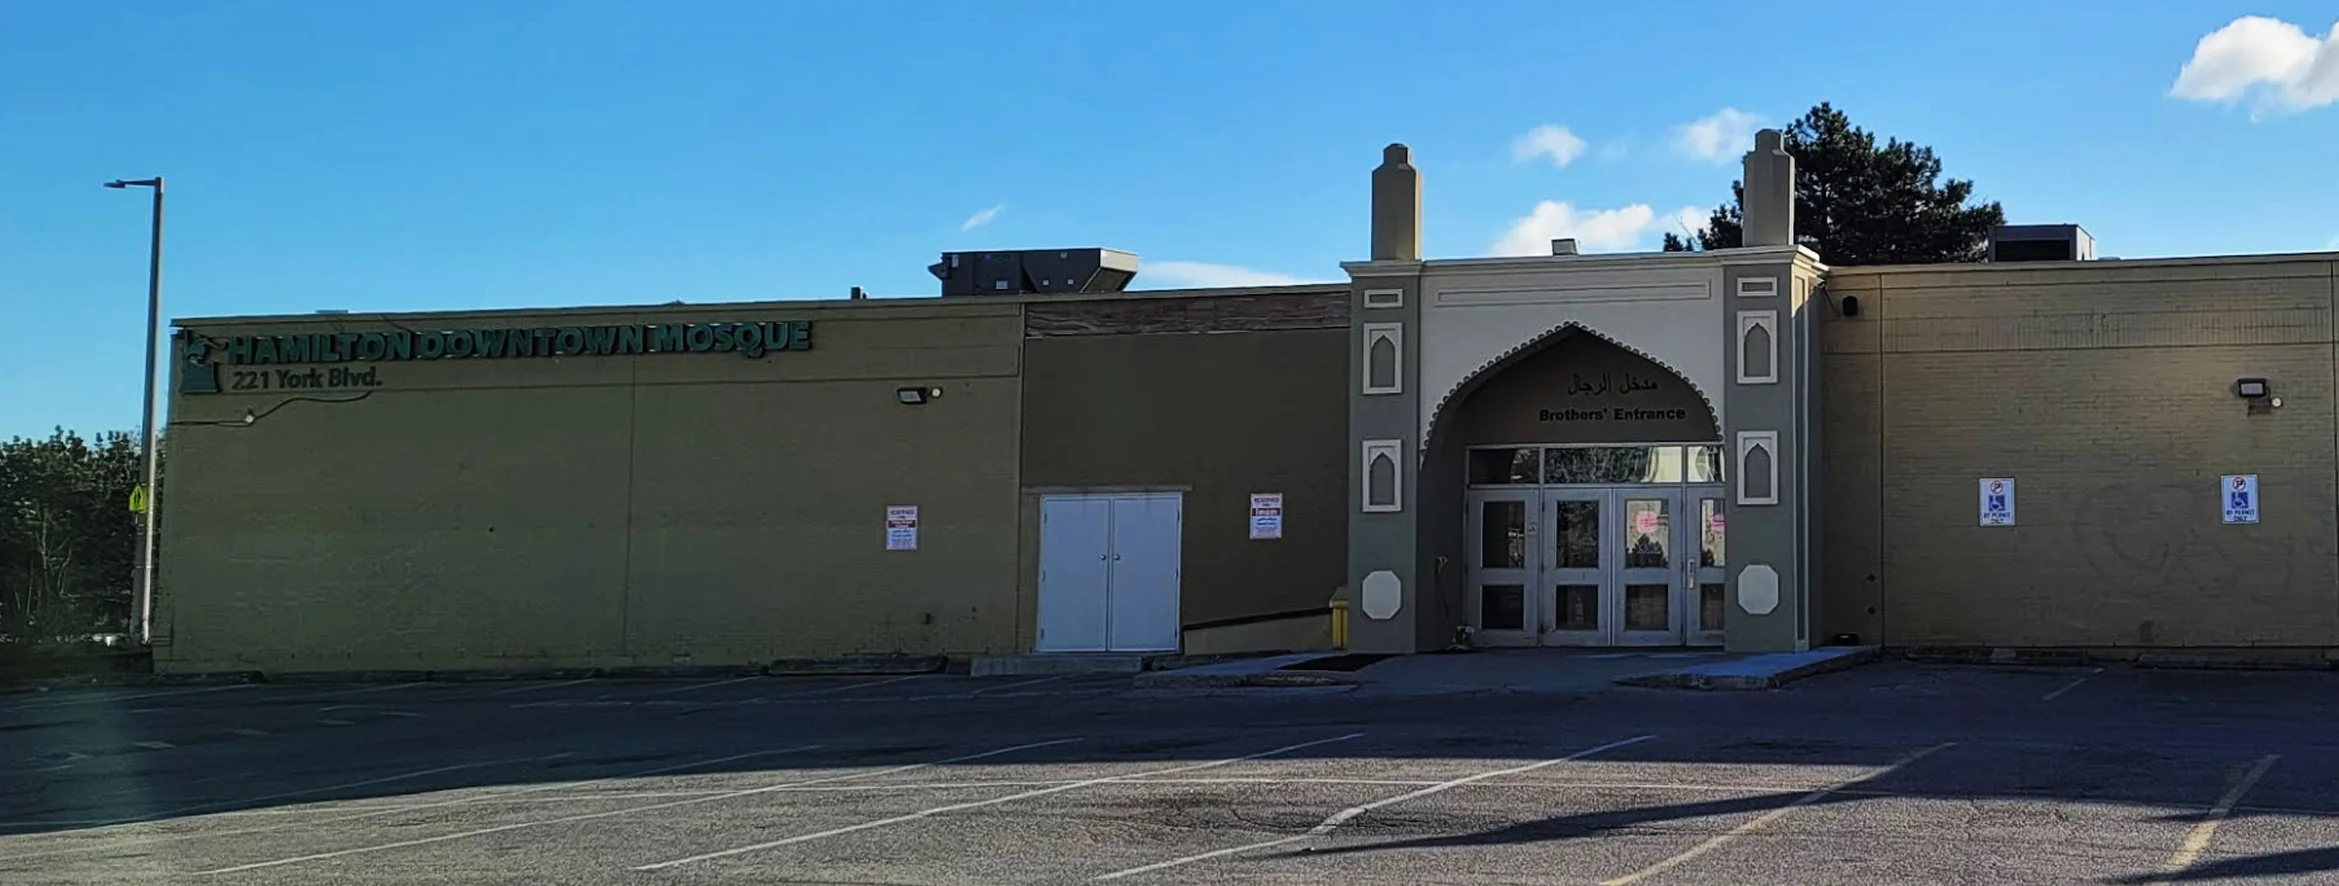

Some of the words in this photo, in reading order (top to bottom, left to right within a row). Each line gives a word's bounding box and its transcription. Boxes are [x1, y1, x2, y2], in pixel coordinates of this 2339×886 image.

[227, 332, 412, 364] HAMILTON
[416, 327, 643, 359] DOWNTOWN
[651, 320, 812, 358] MOSQUE
[231, 371, 269, 390] 221
[275, 368, 322, 389] York
[328, 366, 383, 388] Blvd.
[1567, 372, 1611, 395] الرجال
[1619, 372, 1658, 394] مدخل
[1539, 407, 1608, 422] Brothers'
[1614, 407, 1686, 421] Entrance
